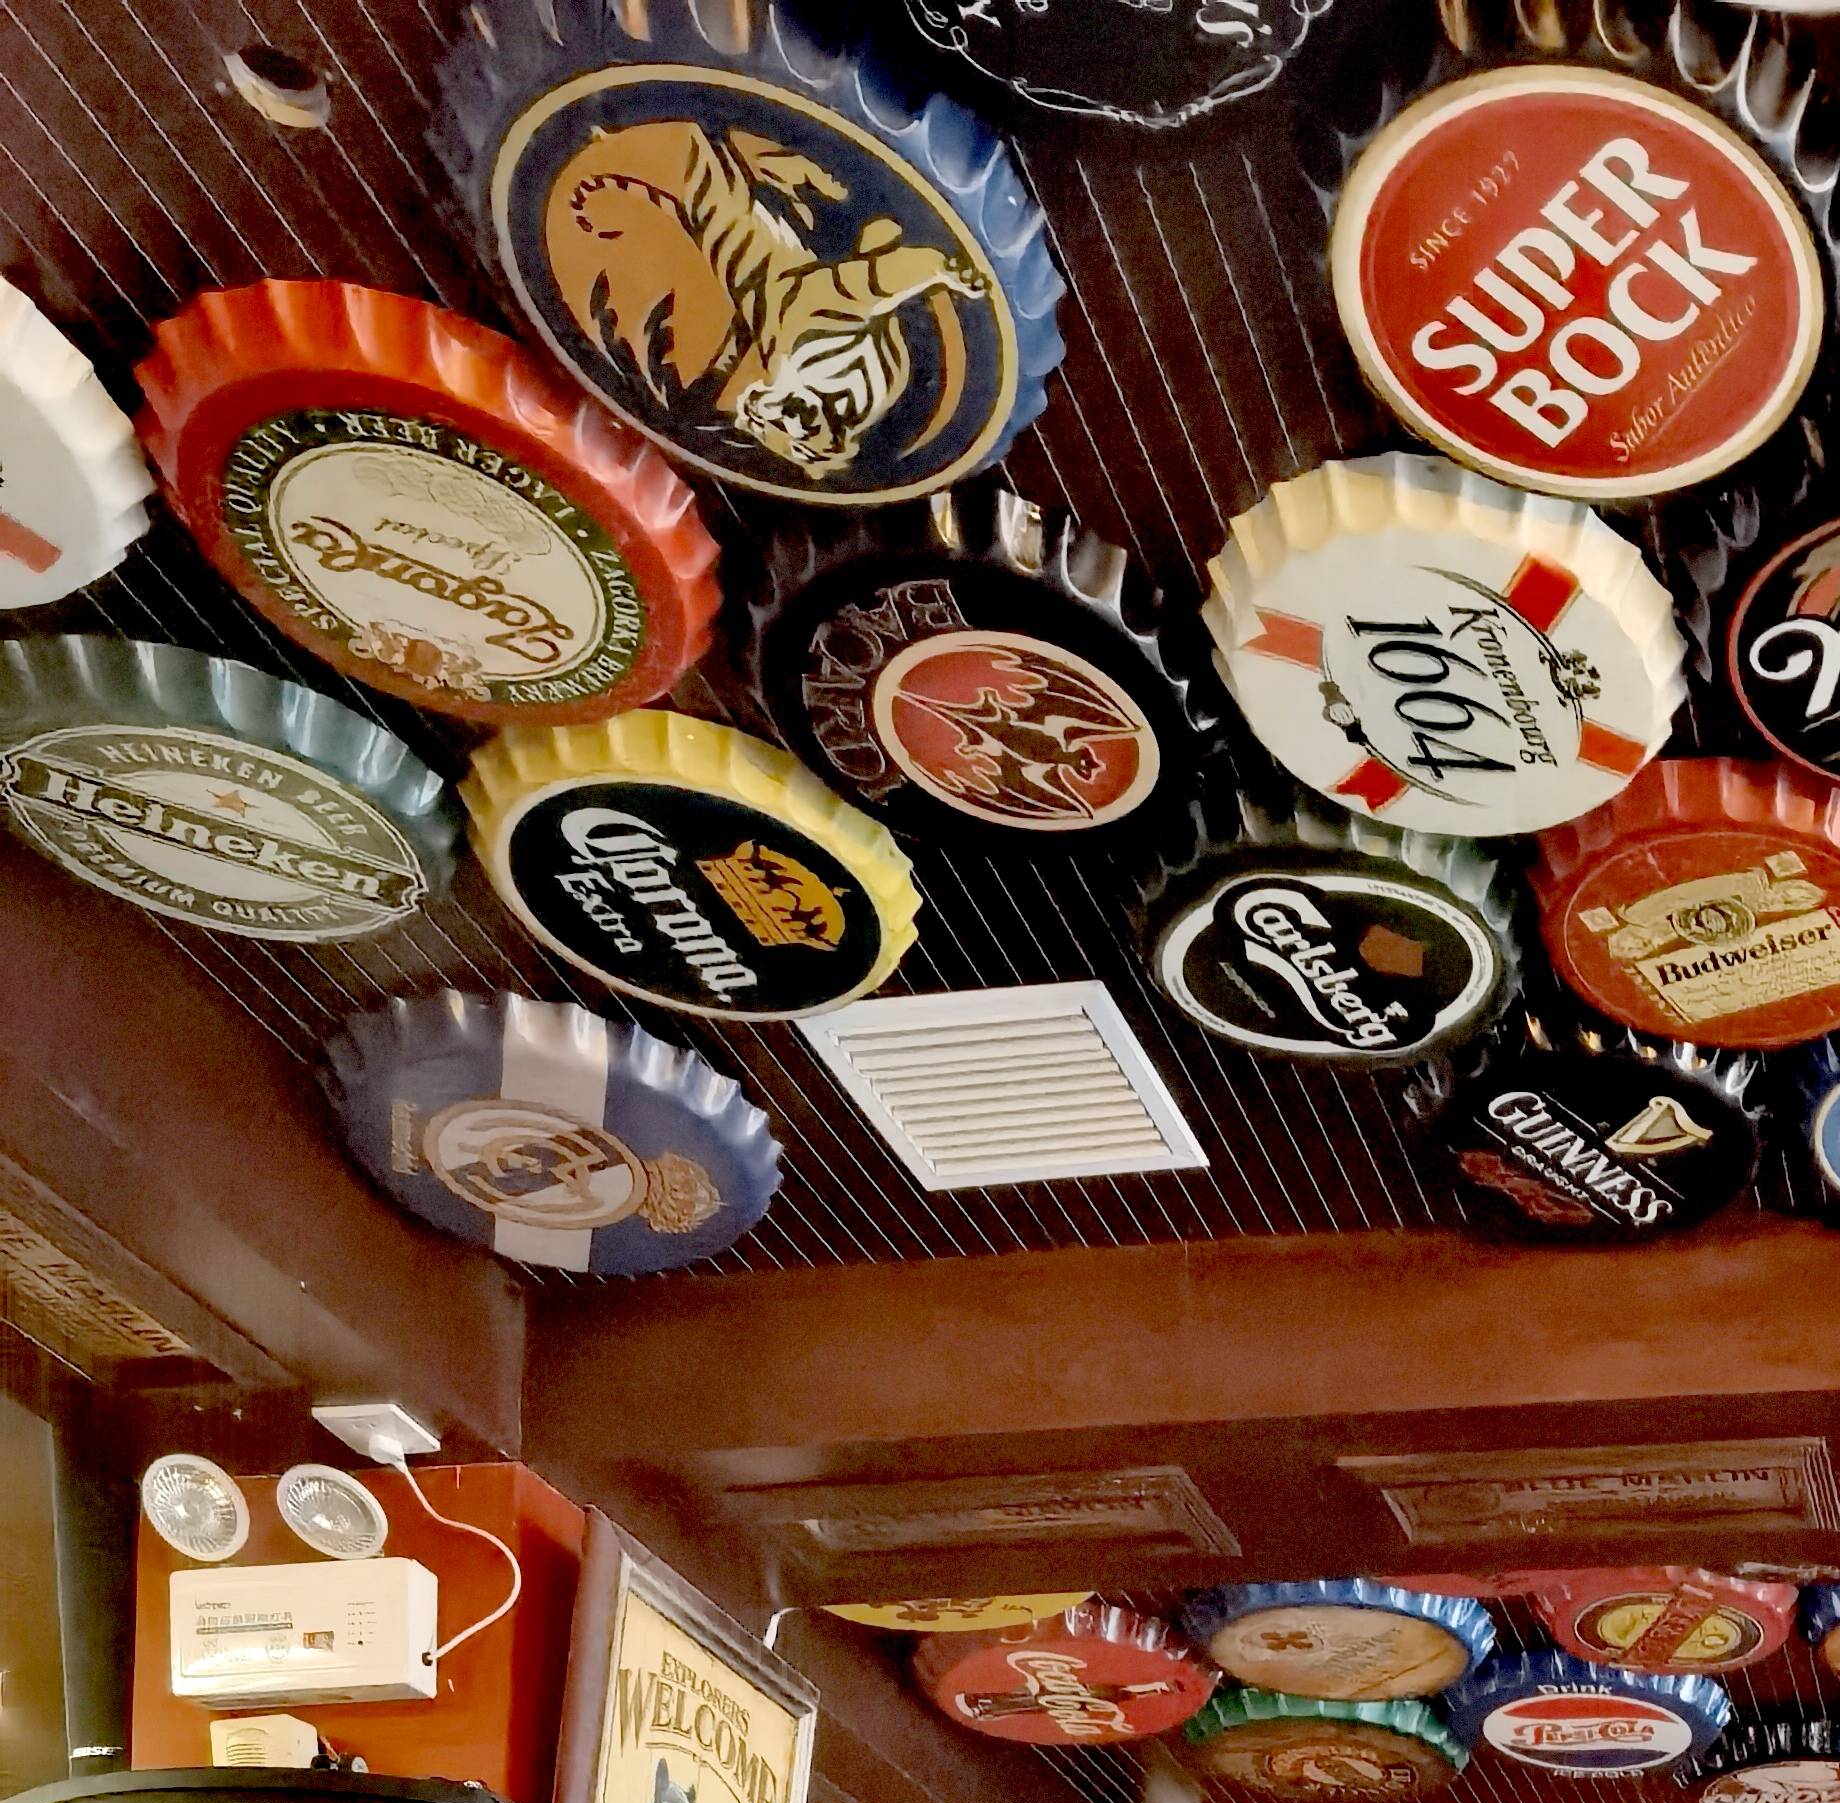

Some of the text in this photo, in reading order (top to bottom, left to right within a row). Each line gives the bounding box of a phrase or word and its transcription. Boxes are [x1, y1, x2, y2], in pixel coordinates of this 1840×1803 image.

[1408, 204, 1473, 273] SINCE
[1410, 136, 1691, 397] SUPER
[1489, 207, 1758, 449] BOCK
[335, 411, 577, 521] LAGER BEER
[1608, 392, 1666, 464] Sabor
[291, 514, 574, 664] Zagorka
[1344, 613, 1517, 783] 1664
[44, 768, 383, 899] Heineken
[98, 741, 370, 837] HEINEKEN BEER
[554, 869, 643, 954] Extra
[559, 806, 759, 1004] Corona
[1655, 921, 1833, 989] Budweiser
[1234, 888, 1410, 1047] Carlsberg
[662, 1650, 751, 1737] EXPLORERS
[70, 1746, 124, 1758] BOSE
